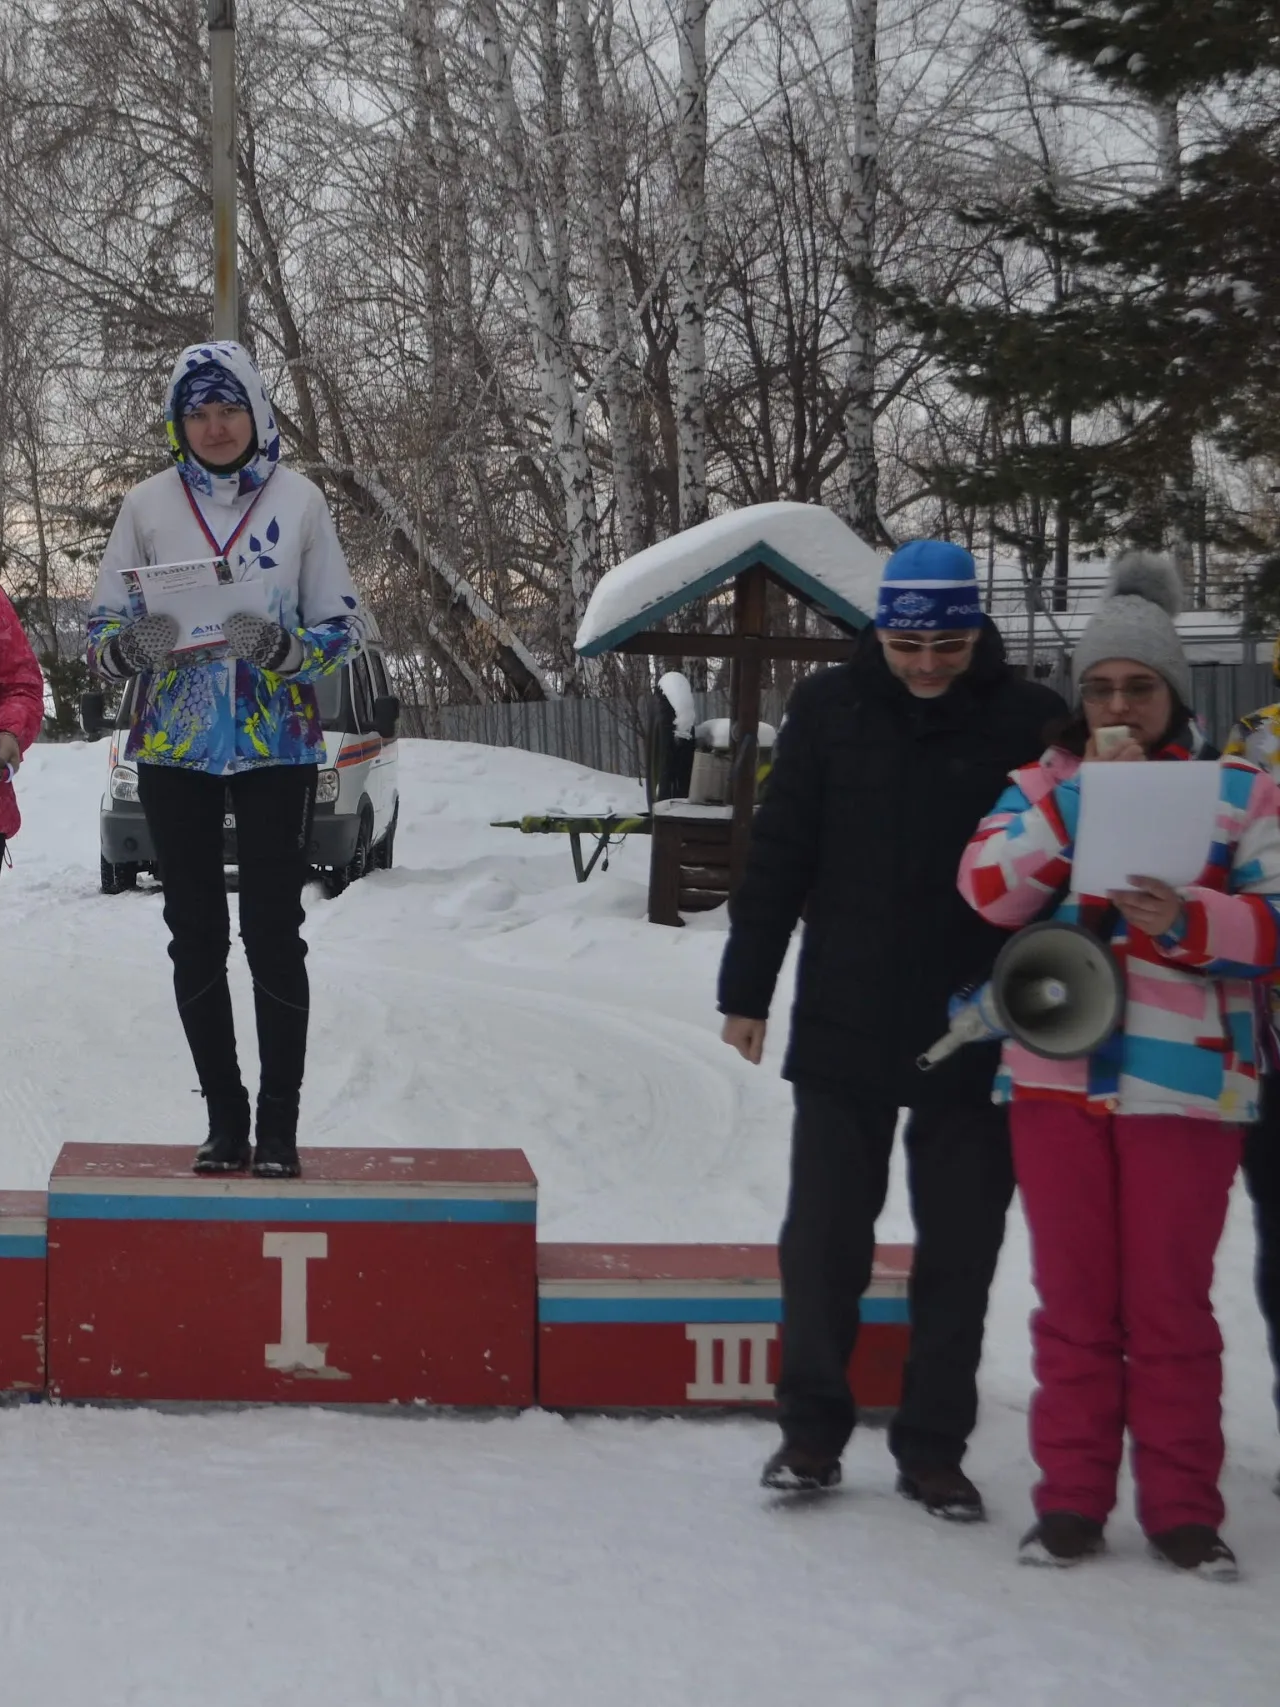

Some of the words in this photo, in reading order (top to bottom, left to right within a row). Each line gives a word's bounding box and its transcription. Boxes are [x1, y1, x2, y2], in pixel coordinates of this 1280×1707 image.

[146, 563, 207, 579] ГРАМОТА
[887, 618, 937, 628] 2014
[262, 1232, 329, 1375] I
[685, 1323, 777, 1400] III
